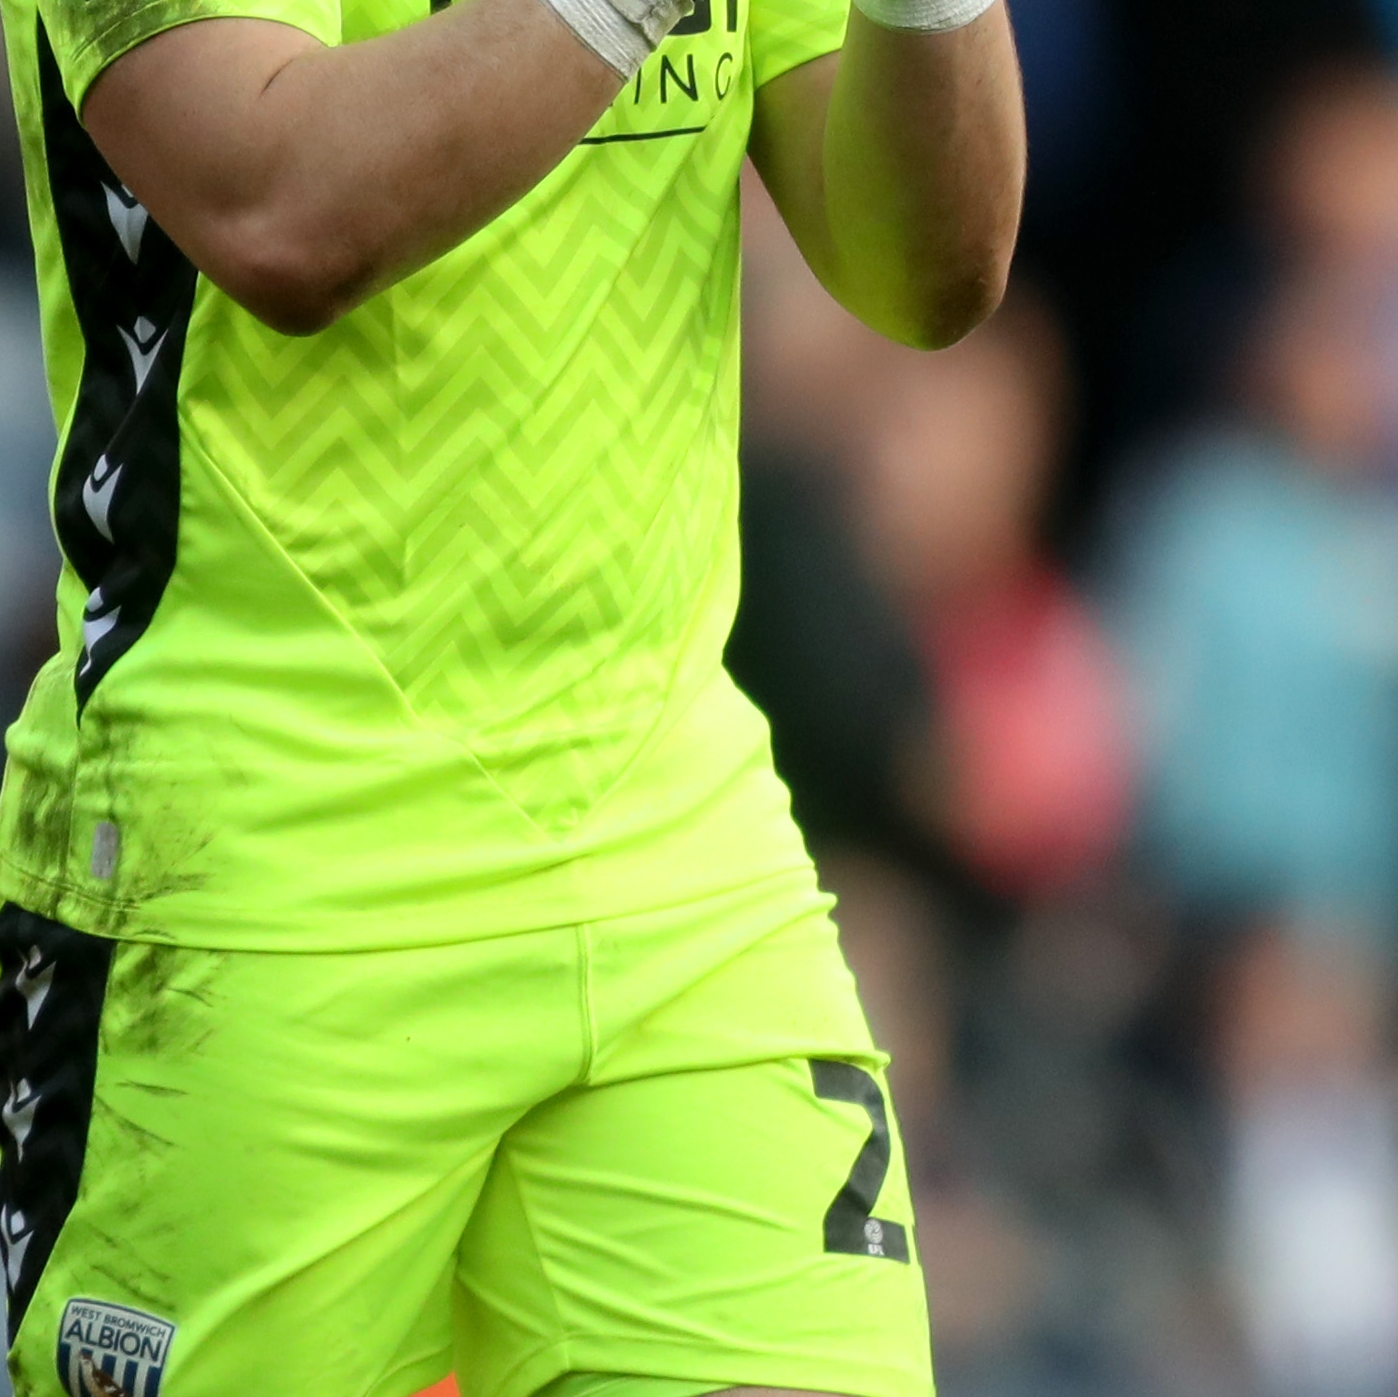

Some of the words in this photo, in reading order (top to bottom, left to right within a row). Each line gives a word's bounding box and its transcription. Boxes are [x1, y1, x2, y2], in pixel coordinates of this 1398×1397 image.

[807, 1058, 911, 1265] 2
[64, 1318, 163, 1362] ALBION
[71, 1305, 102, 1321] WEST
[104, 1314, 166, 1337] BROMWICH
